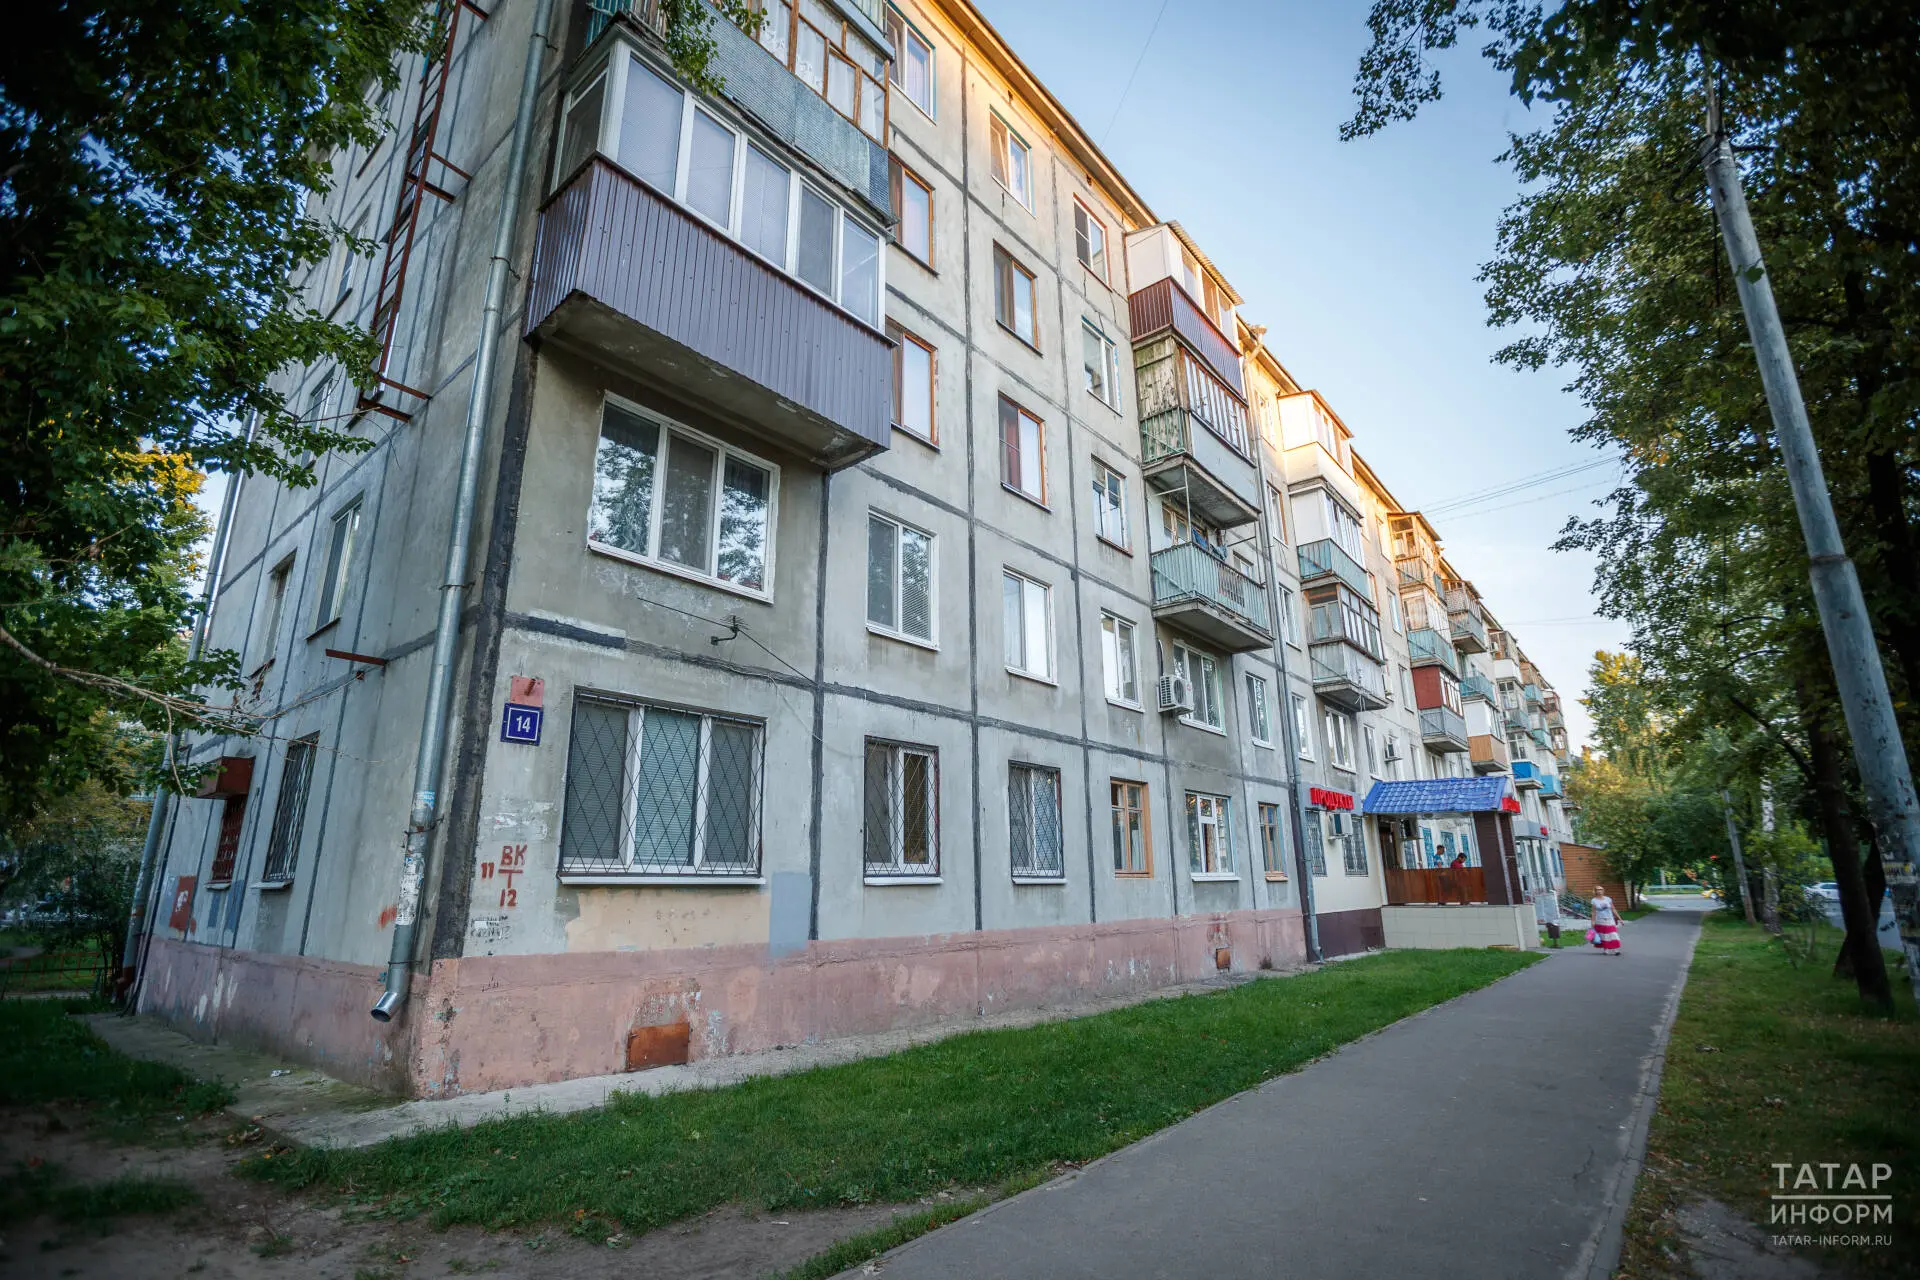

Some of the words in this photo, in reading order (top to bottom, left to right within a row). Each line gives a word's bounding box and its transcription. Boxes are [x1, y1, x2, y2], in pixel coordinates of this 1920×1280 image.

[516, 715, 531, 733] 14
[500, 844, 528, 867] ВК
[481, 861, 495, 880] 11
[500, 888, 518, 908] 12
